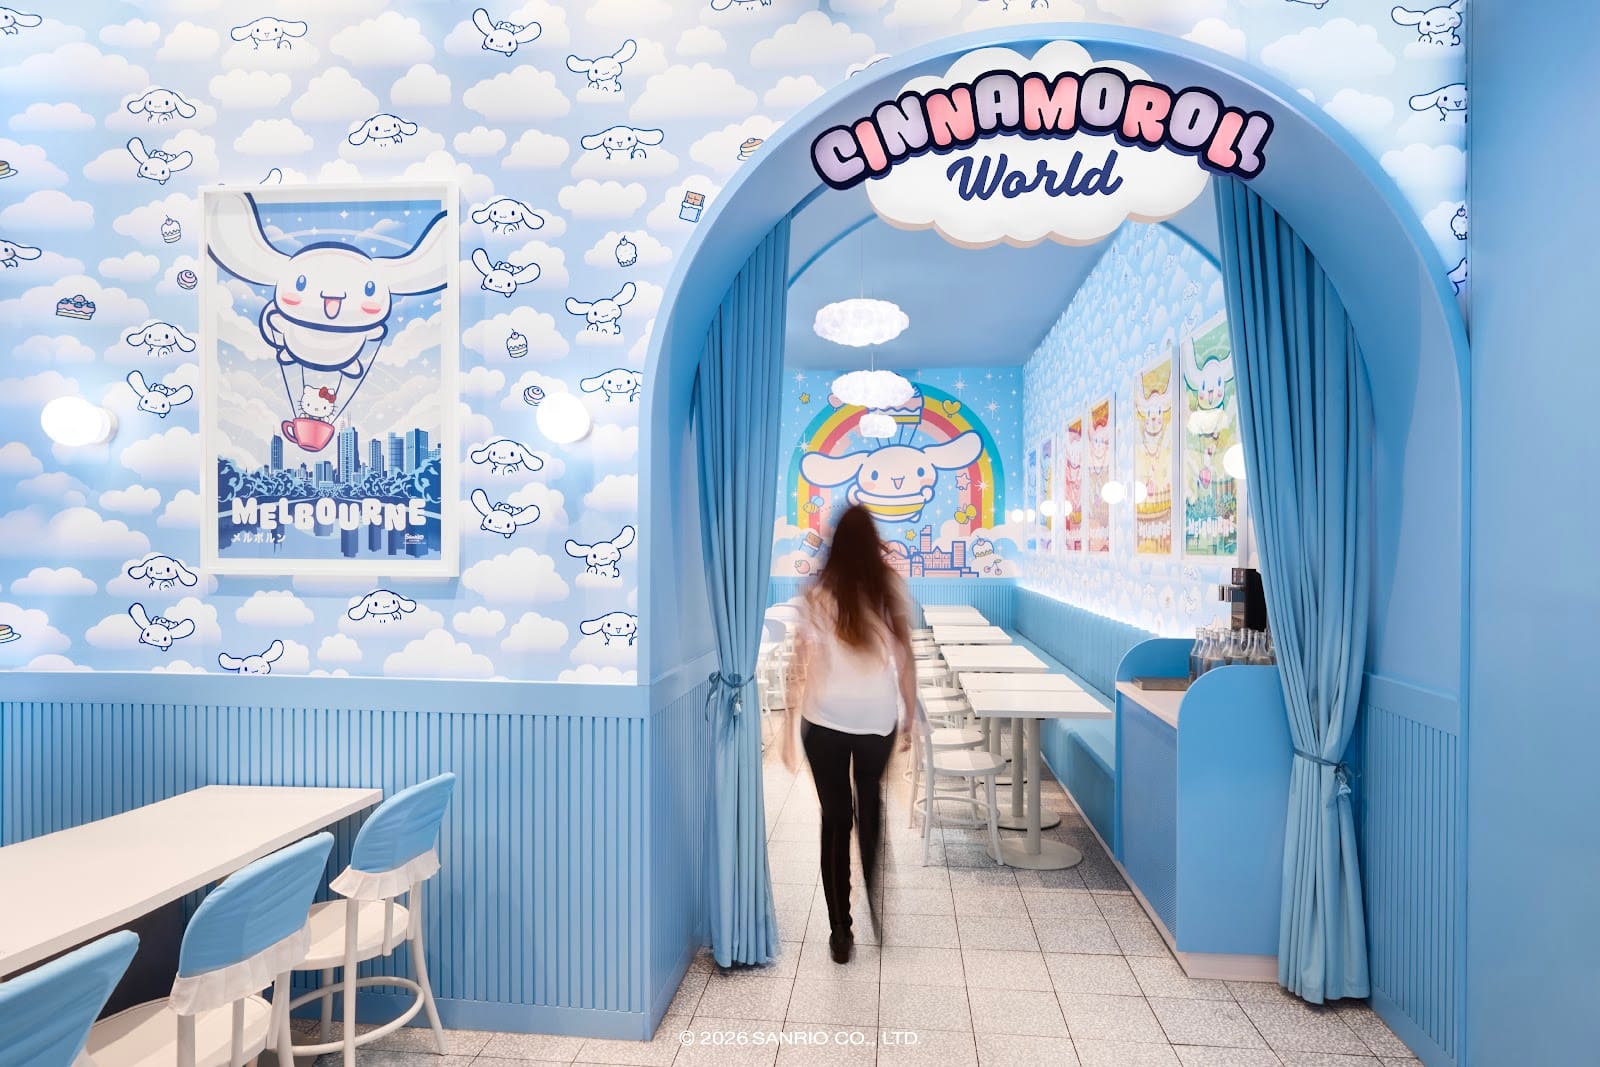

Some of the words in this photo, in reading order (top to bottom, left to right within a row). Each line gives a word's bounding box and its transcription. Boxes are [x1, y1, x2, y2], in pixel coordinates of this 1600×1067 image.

[810, 67, 1274, 190] CINNAMOROLL
[946, 149, 1124, 201] World
[231, 497, 427, 531] MELBOURNE
